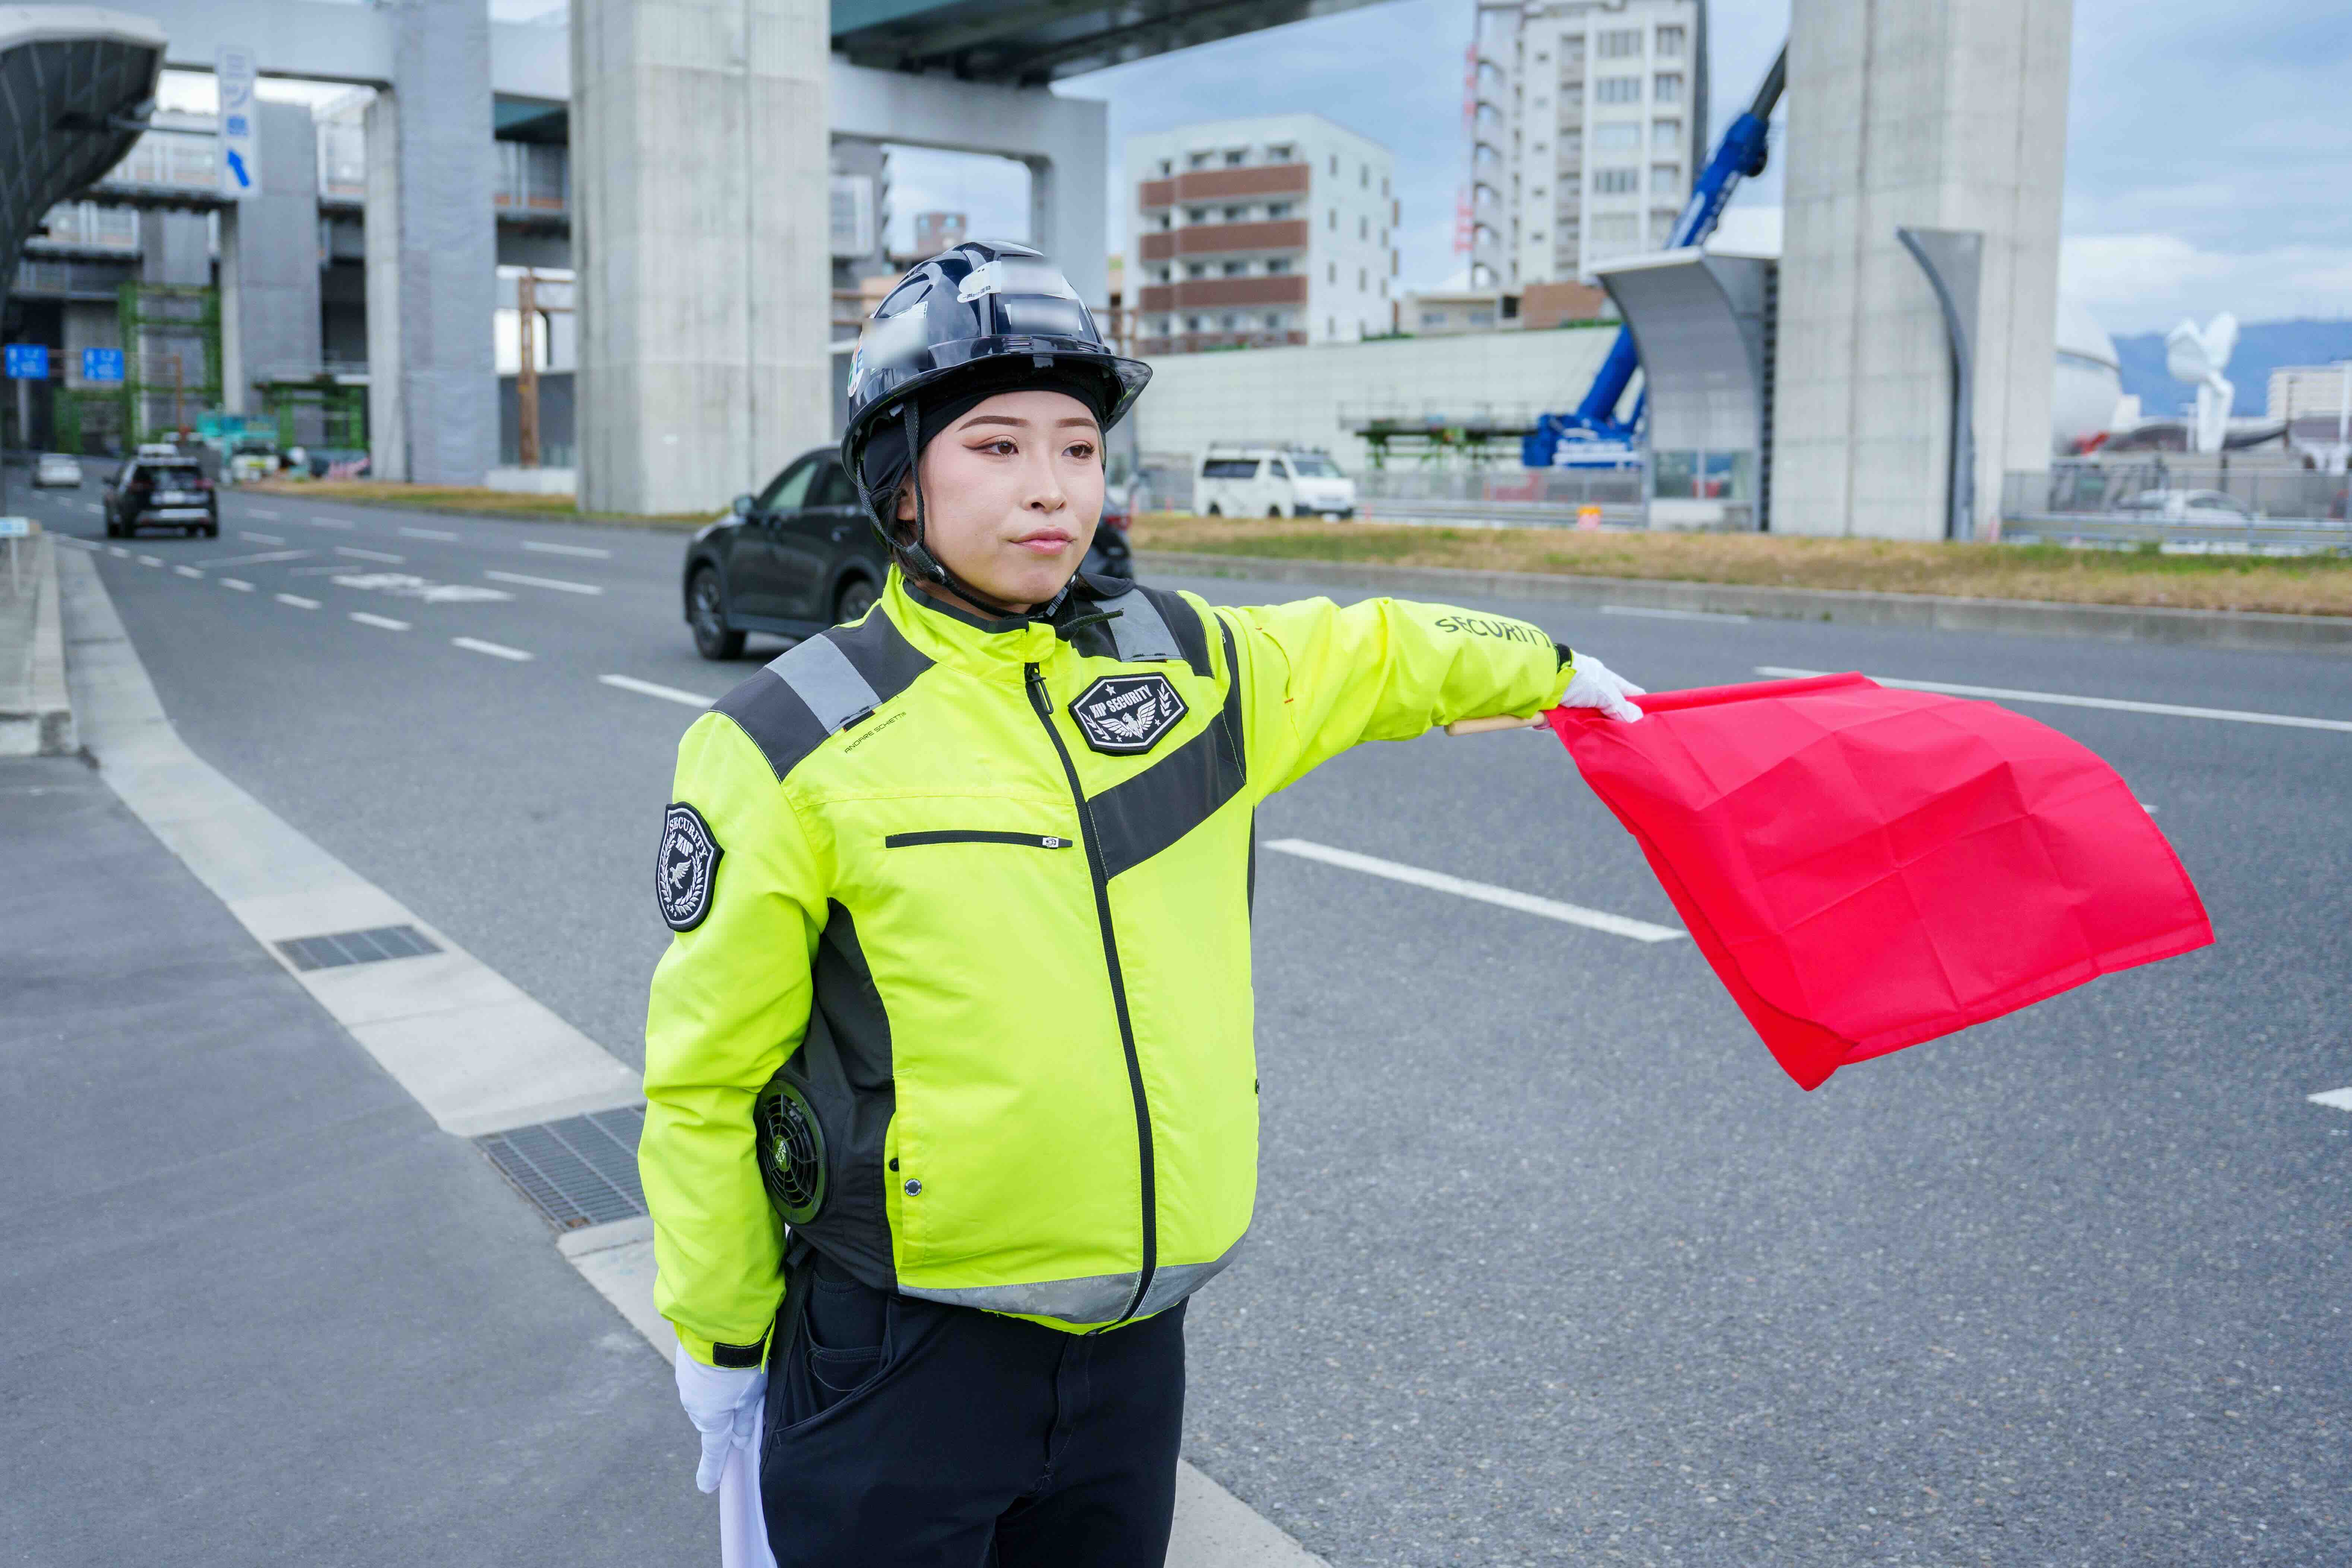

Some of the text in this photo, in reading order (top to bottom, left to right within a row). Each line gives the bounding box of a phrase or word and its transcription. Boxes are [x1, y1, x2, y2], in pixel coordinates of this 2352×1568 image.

[1089, 685, 1152, 719] ZIP SECURITY
[844, 731, 874, 754] ANDARE
[669, 816, 708, 859] SECURITY
[675, 833, 694, 857] ZIP
